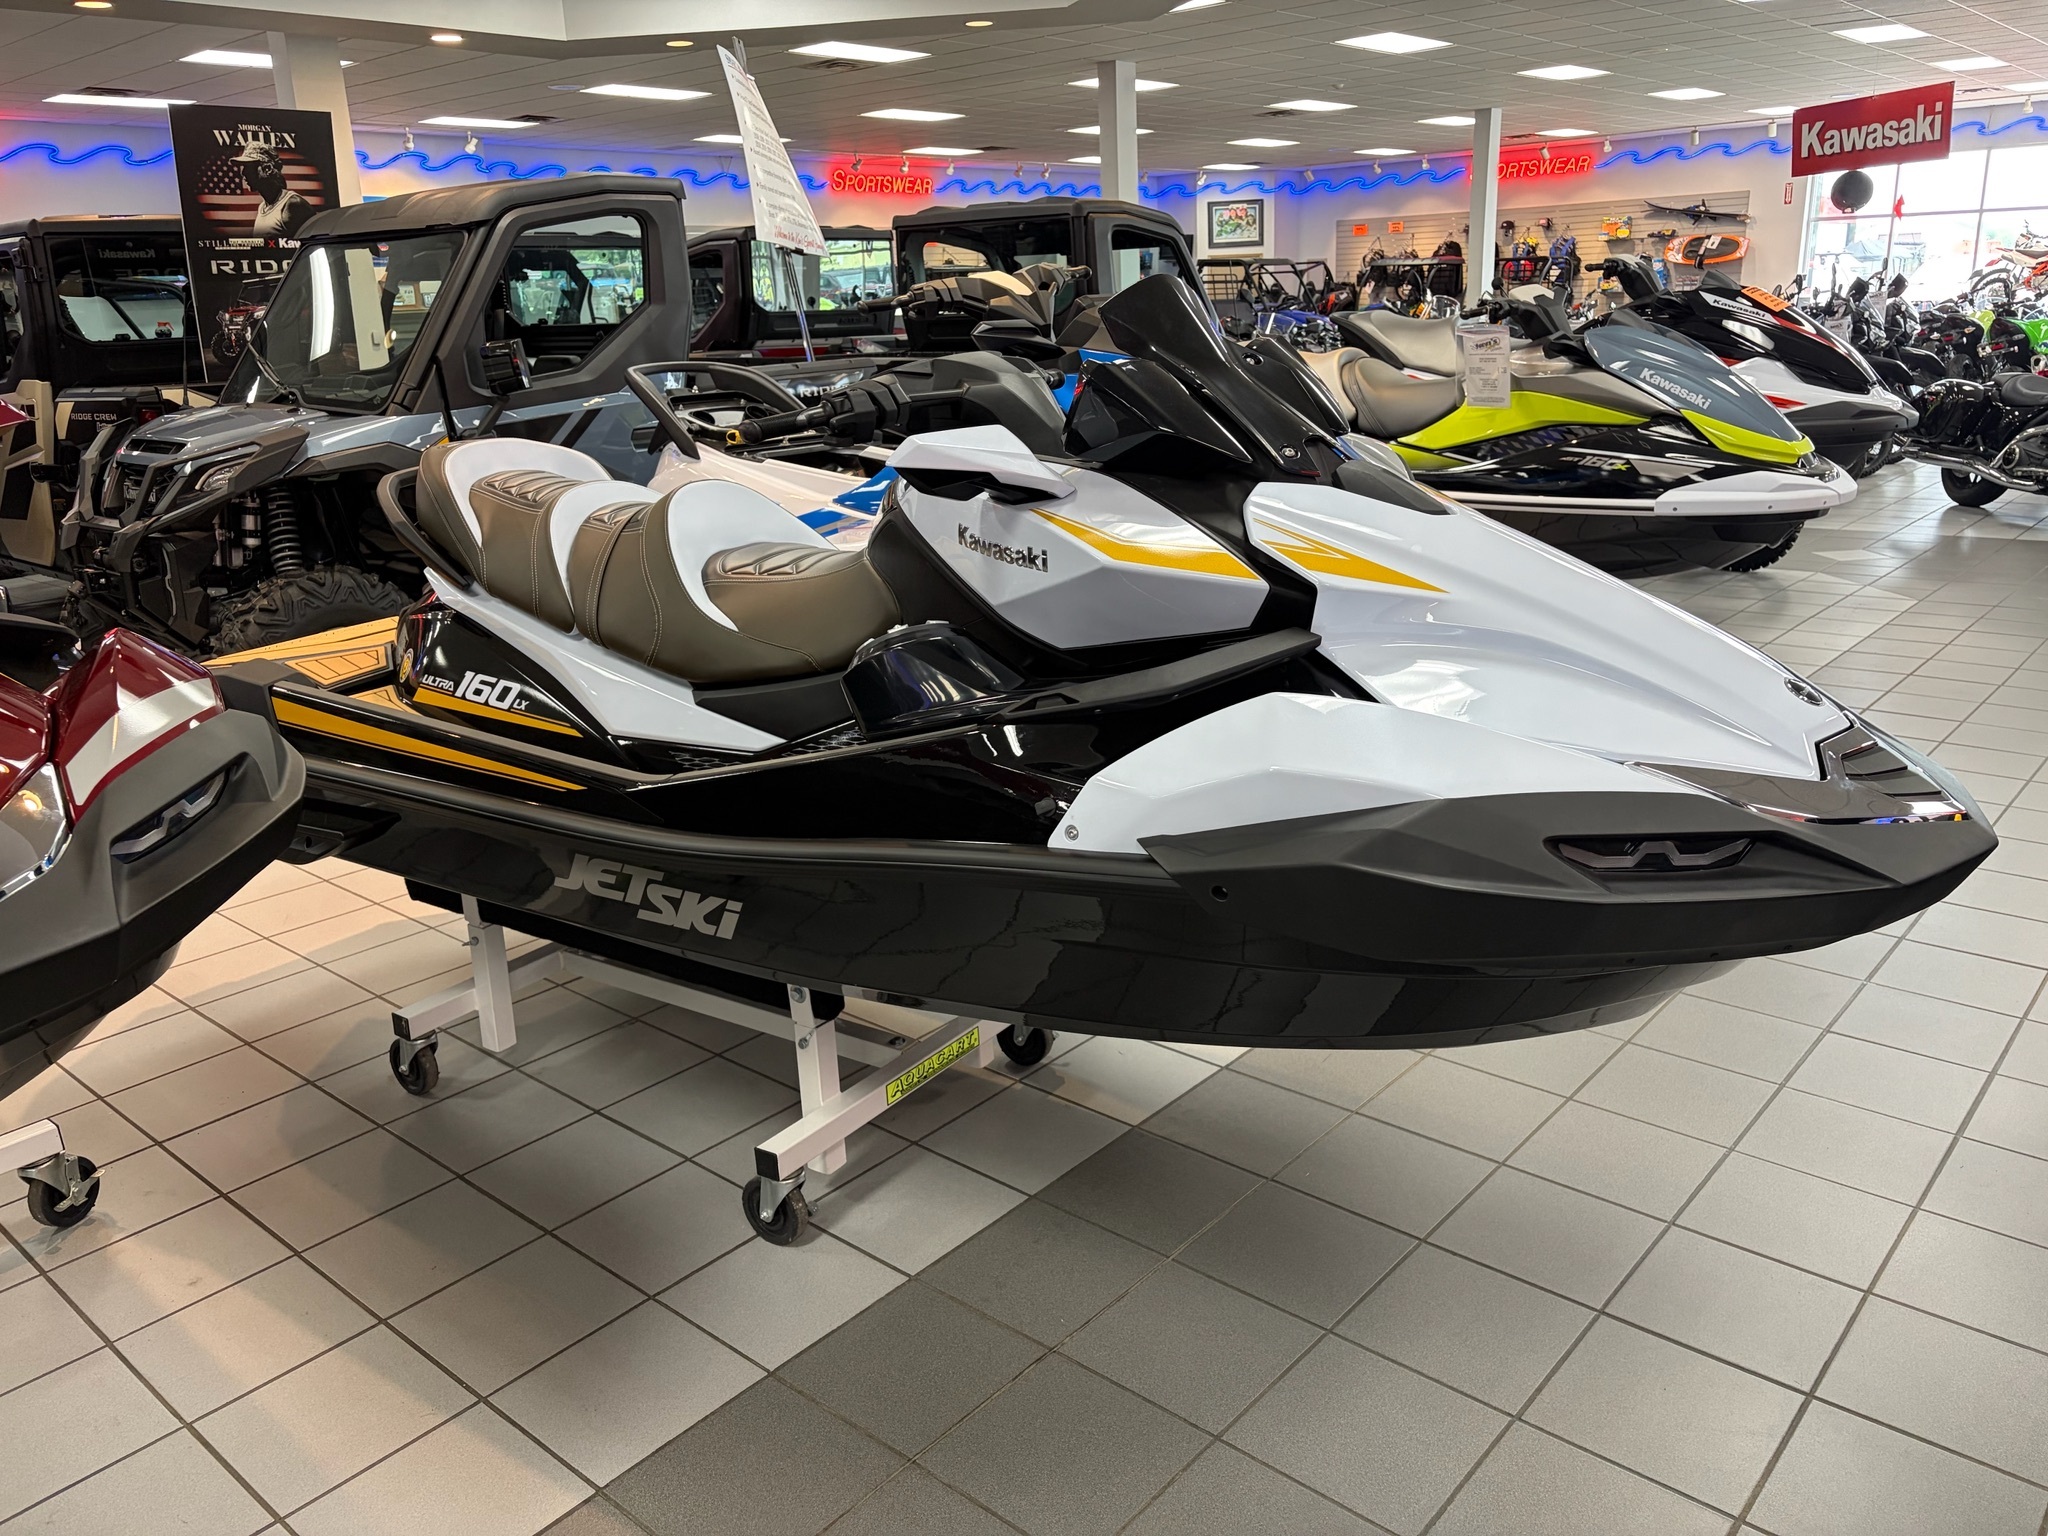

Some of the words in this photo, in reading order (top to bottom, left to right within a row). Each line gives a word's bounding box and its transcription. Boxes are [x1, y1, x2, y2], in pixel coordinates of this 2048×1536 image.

[212, 129, 296, 148] WALLEN
[237, 123, 272, 132] MORGAN
[1801, 101, 1943, 158] Kawasaki
[1497, 156, 1591, 179] ORTSWEAR
[832, 169, 933, 194] SPORTSWEAR
[198, 240, 229, 248] STILL
[1713, 299, 1766, 318] Kawasaki
[1640, 367, 1712, 410] Kawasaki
[958, 522, 1049, 573] Kawasaki
[422, 674, 455, 691] ULTRA
[891, 1031, 975, 1098] AQUACART
